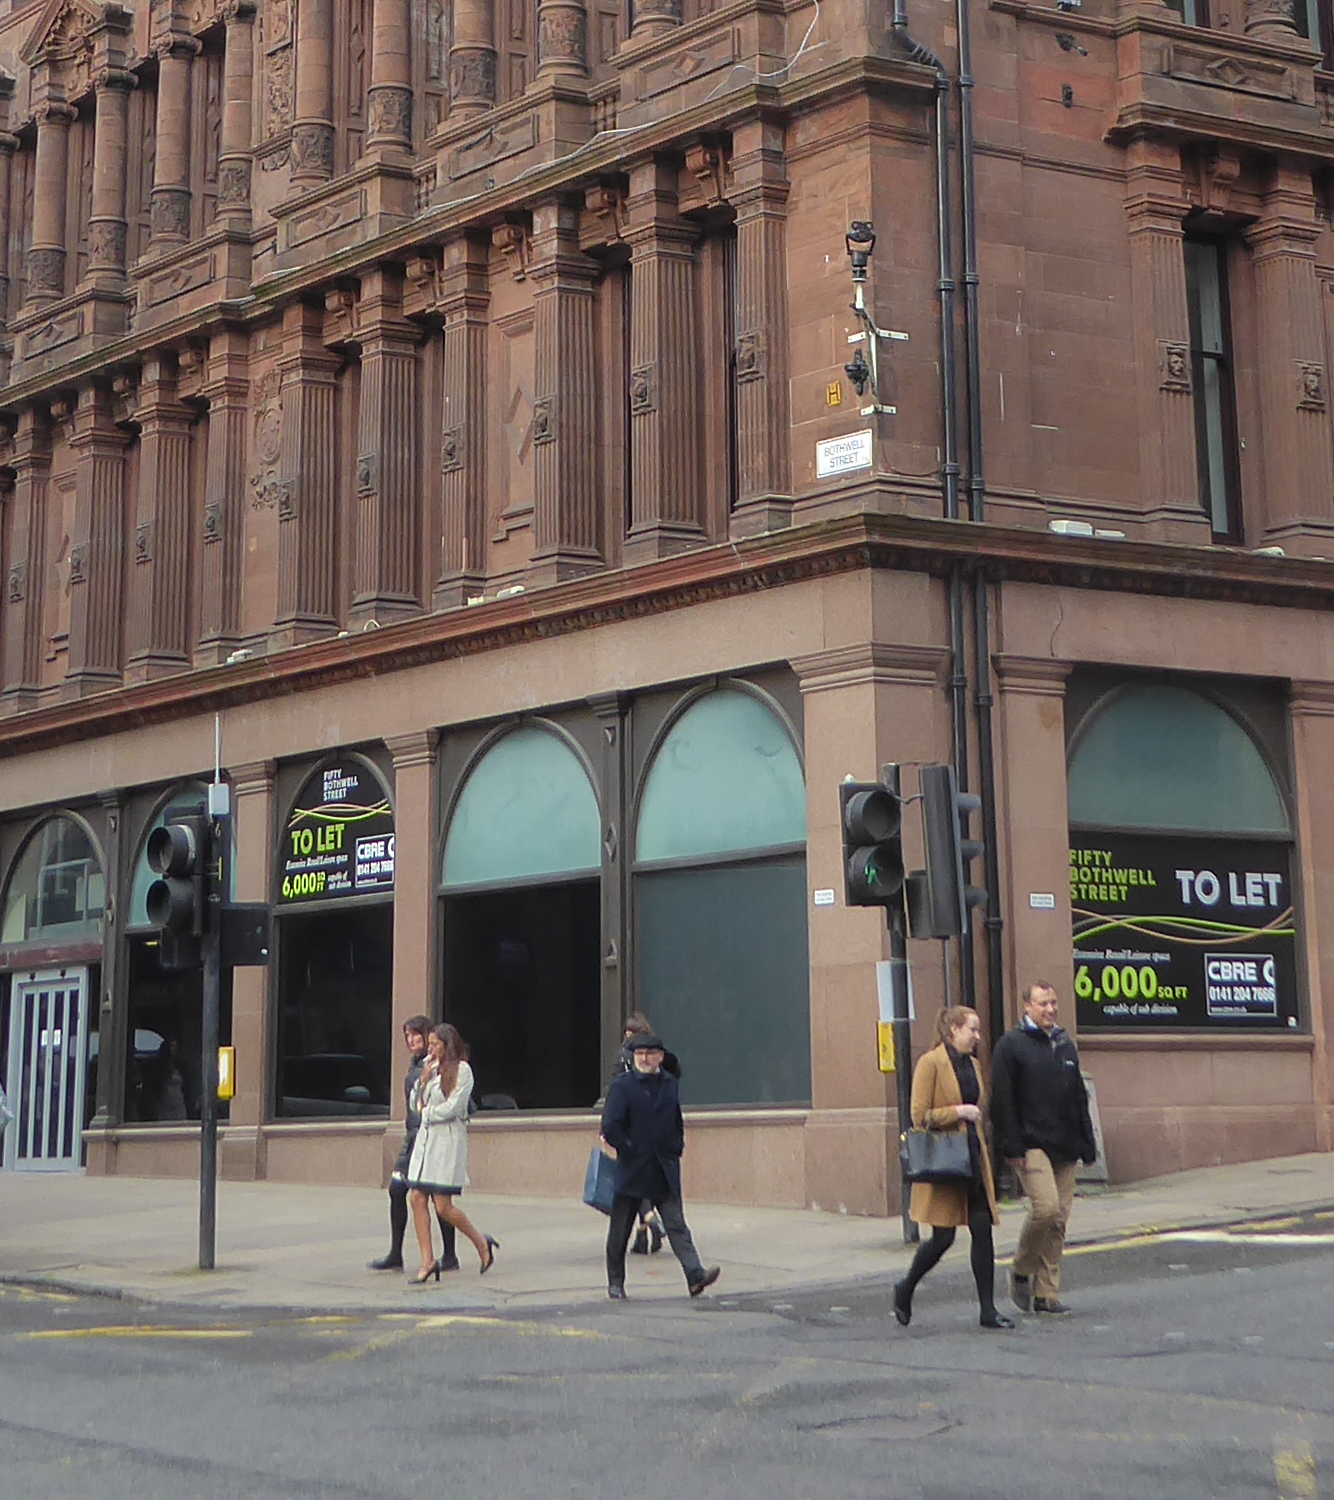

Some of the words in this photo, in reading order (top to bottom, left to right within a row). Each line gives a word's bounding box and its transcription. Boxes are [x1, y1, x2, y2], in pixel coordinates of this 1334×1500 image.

[824, 438, 865, 457] BOTHWELL
[829, 451, 859, 468] STREET
[323, 768, 342, 781] FIFTY
[323, 775, 359, 791] BOTHWELL
[323, 788, 347, 801] STREET
[291, 828, 313, 855] TO
[317, 823, 345, 852] LET
[357, 841, 385, 859] CBRE
[1069, 849, 1113, 867] FIFTY
[282, 872, 316, 898] 6,000
[1069, 866, 1157, 886] BOTHWELL
[1069, 883, 1129, 901] STREET
[1175, 870, 1219, 905] TO
[1229, 871, 1282, 907] LET
[1208, 961, 1257, 981] CBRE
[1075, 965, 1158, 1002] 6,000
[1157, 986, 1173, 999] SQ
[1175, 986, 1188, 999] FT
[1209, 986, 1232, 1001] 0141
[1232, 986, 1251, 1001] 204
